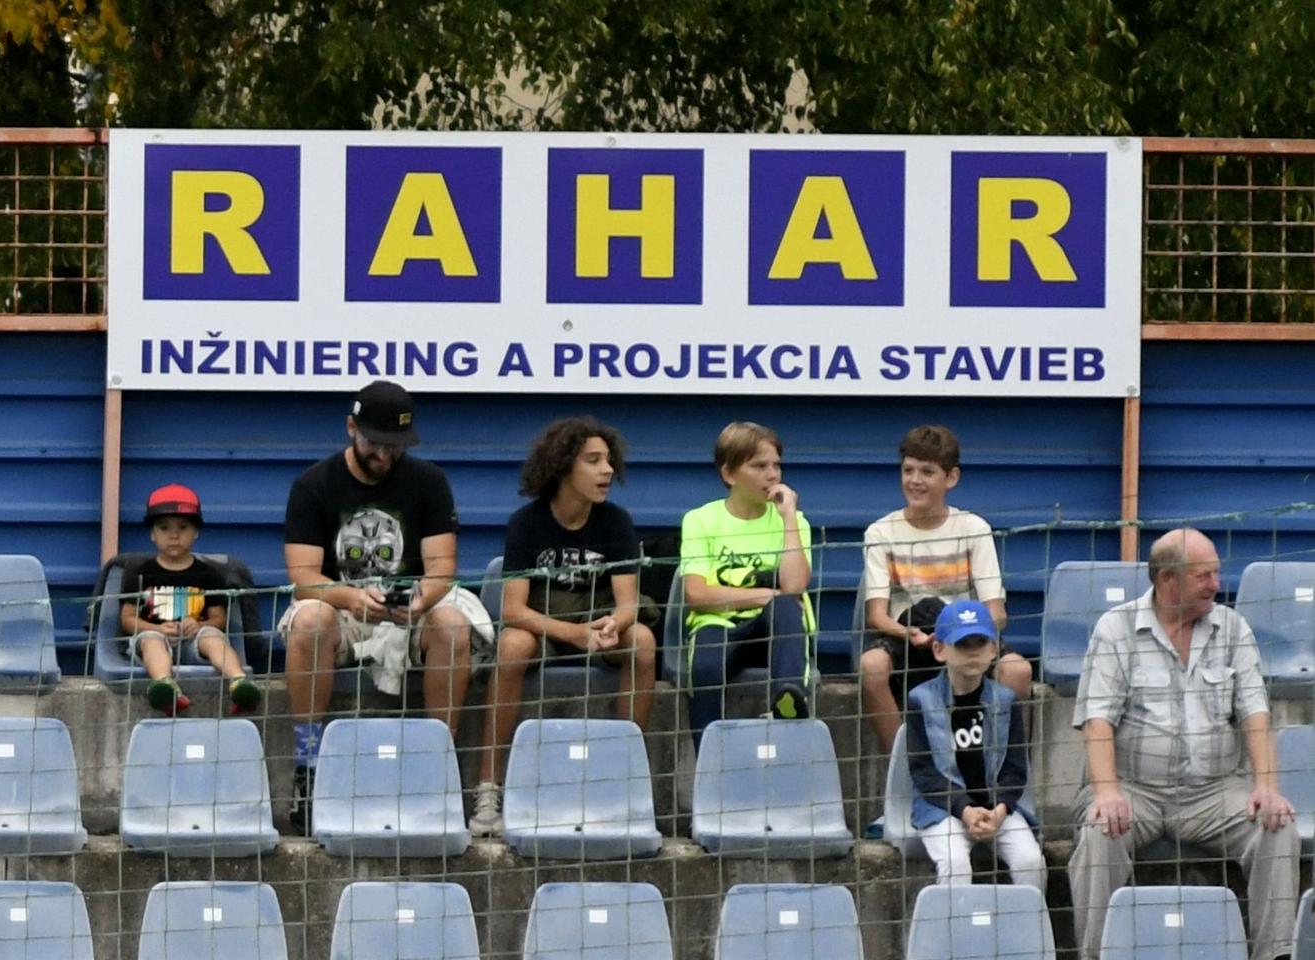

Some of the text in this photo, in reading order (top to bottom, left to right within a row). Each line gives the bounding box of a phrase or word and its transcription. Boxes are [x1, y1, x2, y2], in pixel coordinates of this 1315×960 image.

[170, 169, 1079, 282] RAHAR
[141, 331, 1106, 382] INŽINIERING A PROJEKCIA STAVIEB
